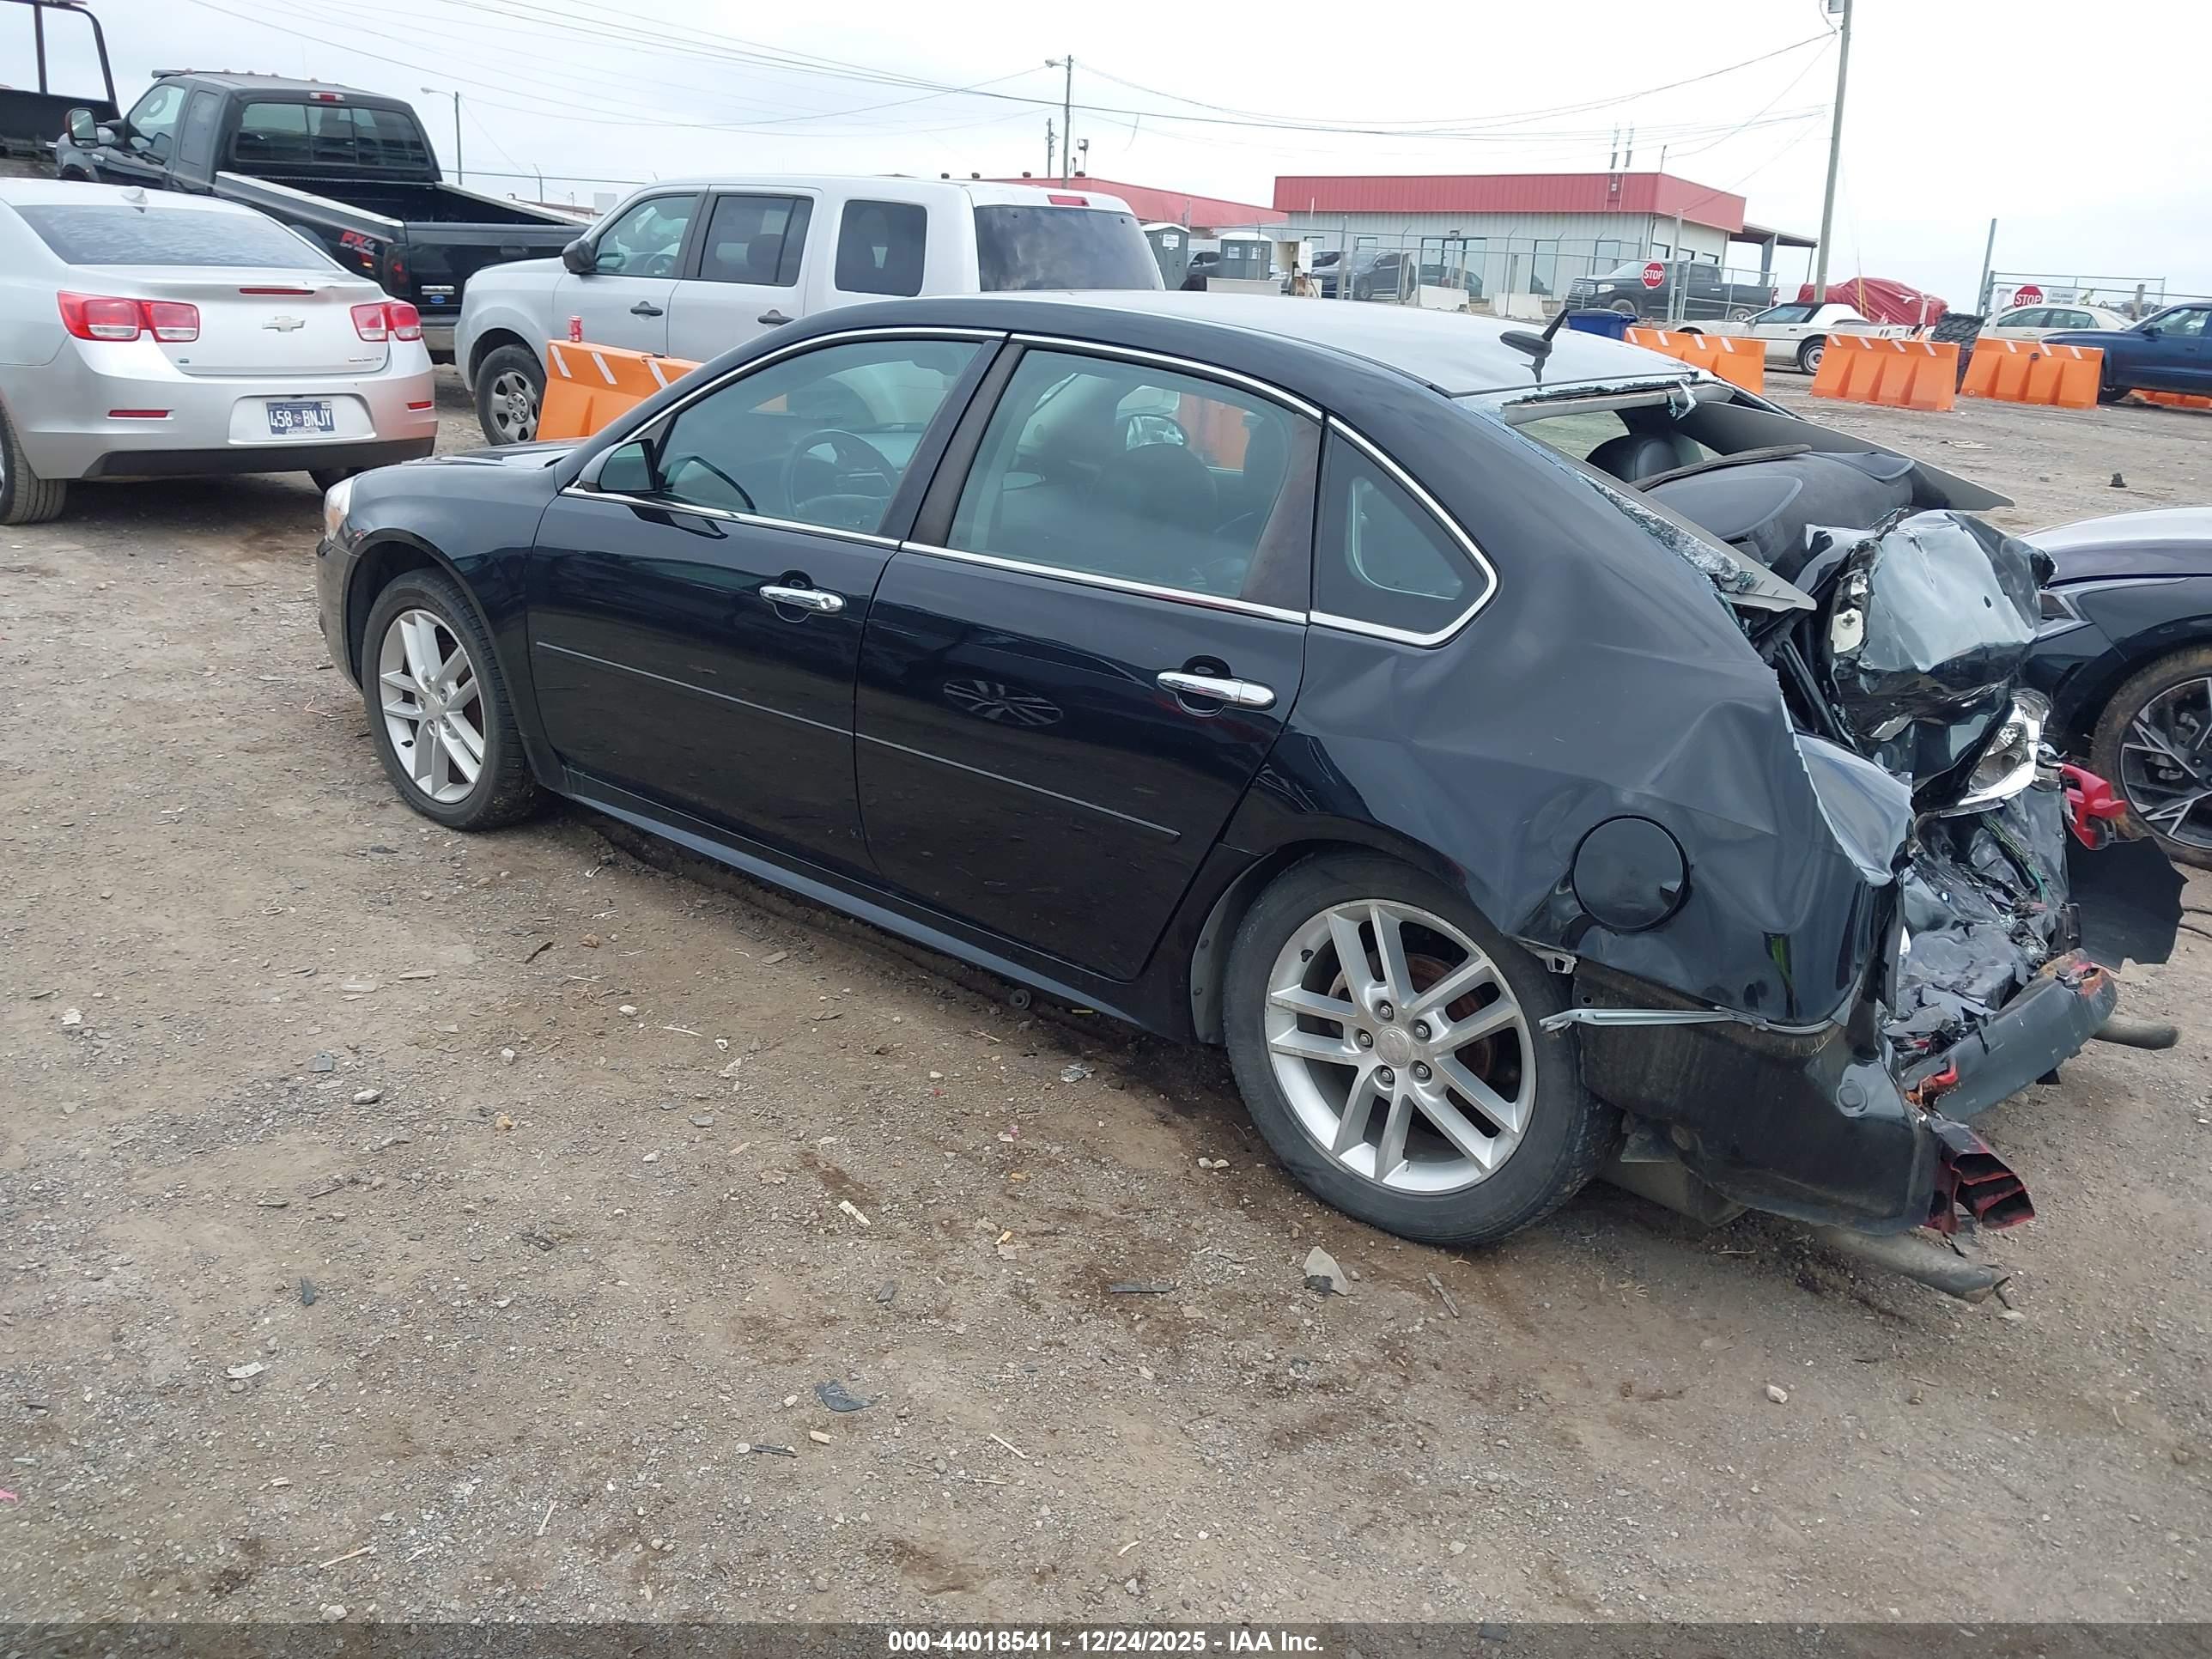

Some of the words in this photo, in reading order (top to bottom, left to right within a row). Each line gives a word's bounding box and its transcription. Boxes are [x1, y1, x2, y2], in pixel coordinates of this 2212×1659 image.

[342, 231, 376, 250] FX4
[1644, 269, 1664, 280] STOP
[2014, 294, 2042, 306] STOP
[270, 410, 294, 428] 458
[301, 409, 331, 427] BNJY
